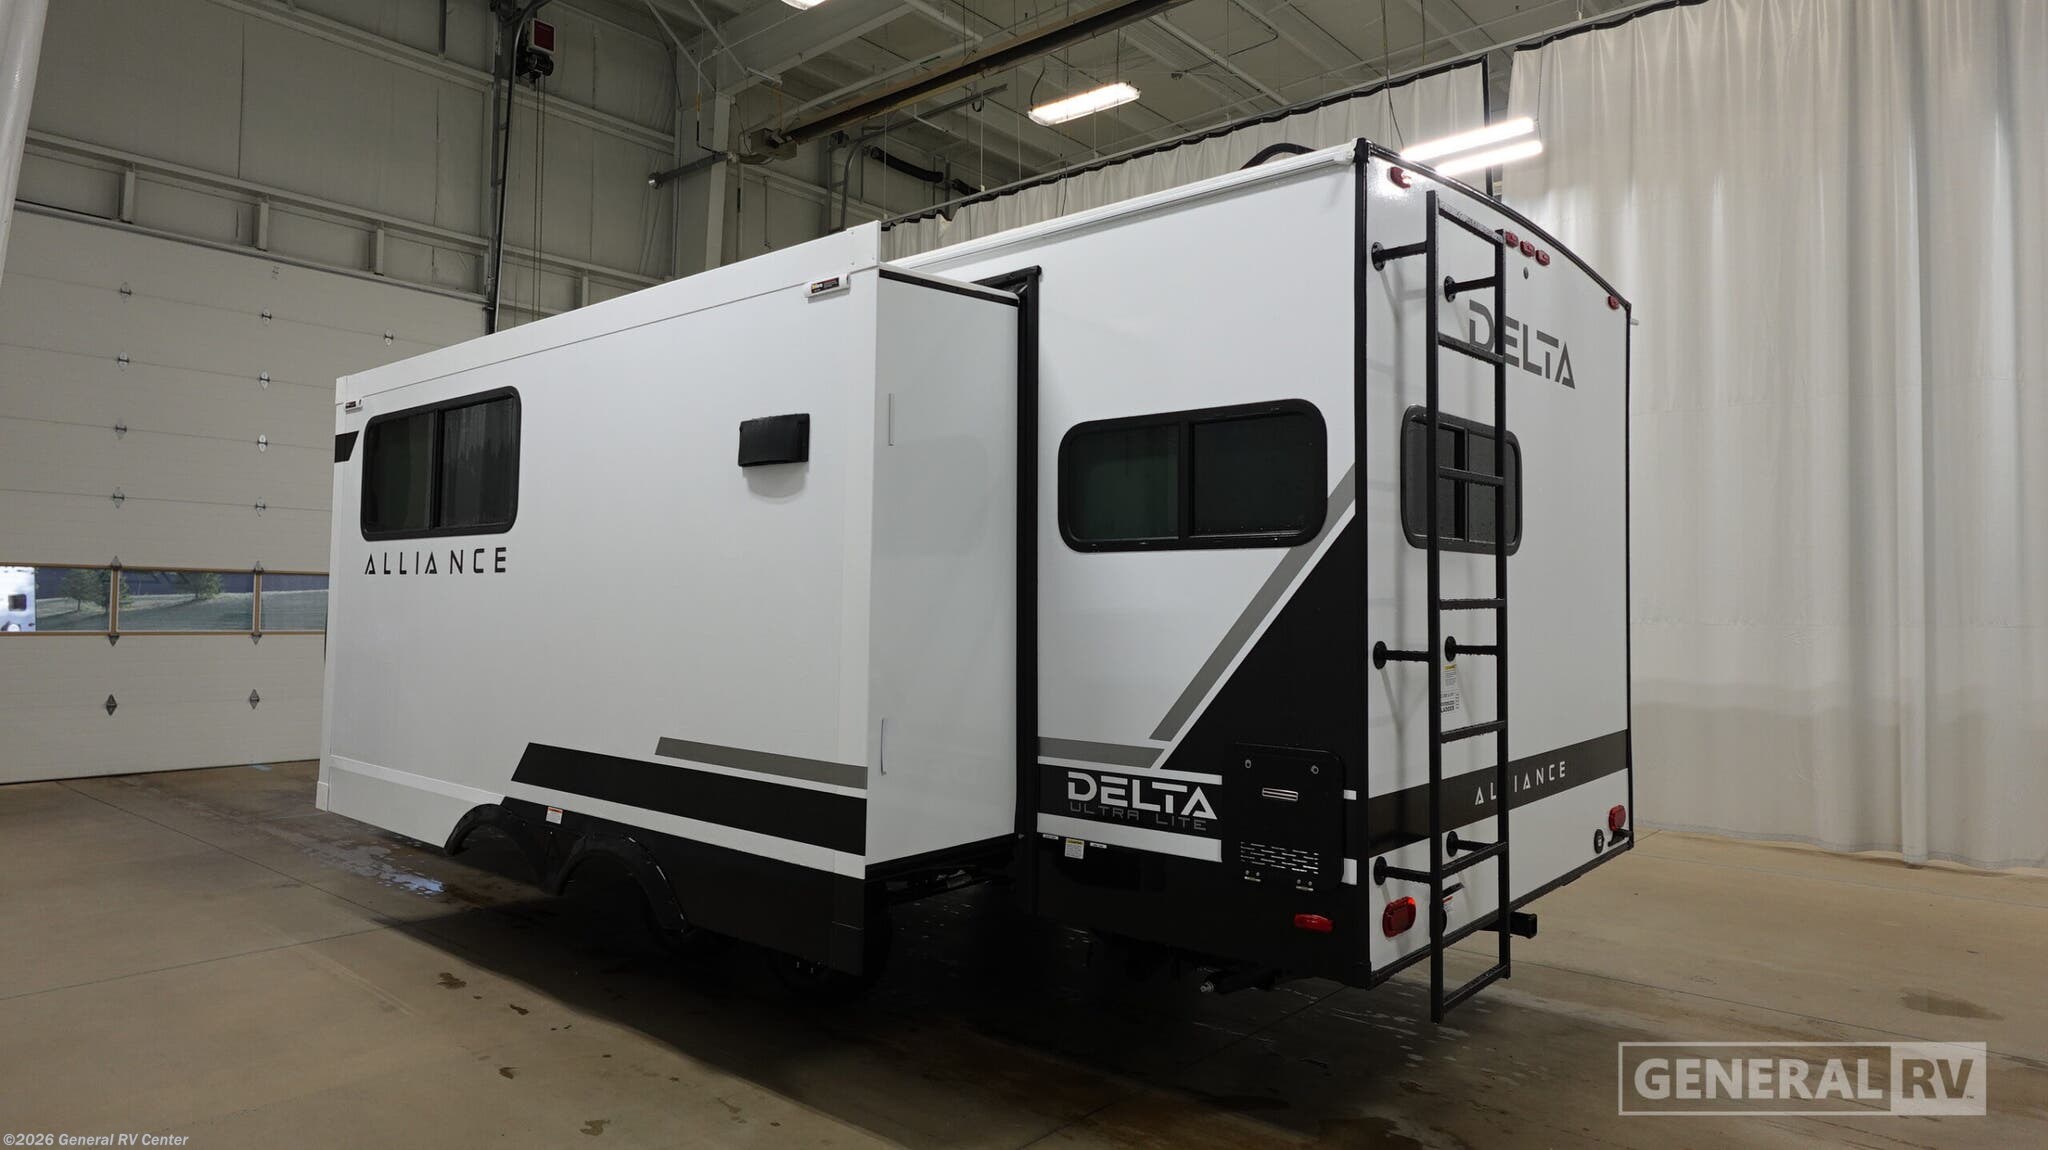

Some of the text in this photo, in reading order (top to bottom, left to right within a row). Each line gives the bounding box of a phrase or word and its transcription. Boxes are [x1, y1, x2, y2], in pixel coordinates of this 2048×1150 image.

[1469, 299, 1576, 389] DELTA
[364, 547, 507, 575] ALLIANCE
[1067, 771, 1218, 820] DELTA
[1474, 760, 1567, 806] ALIANCE
[1069, 801, 1207, 832] ULTRA LITE
